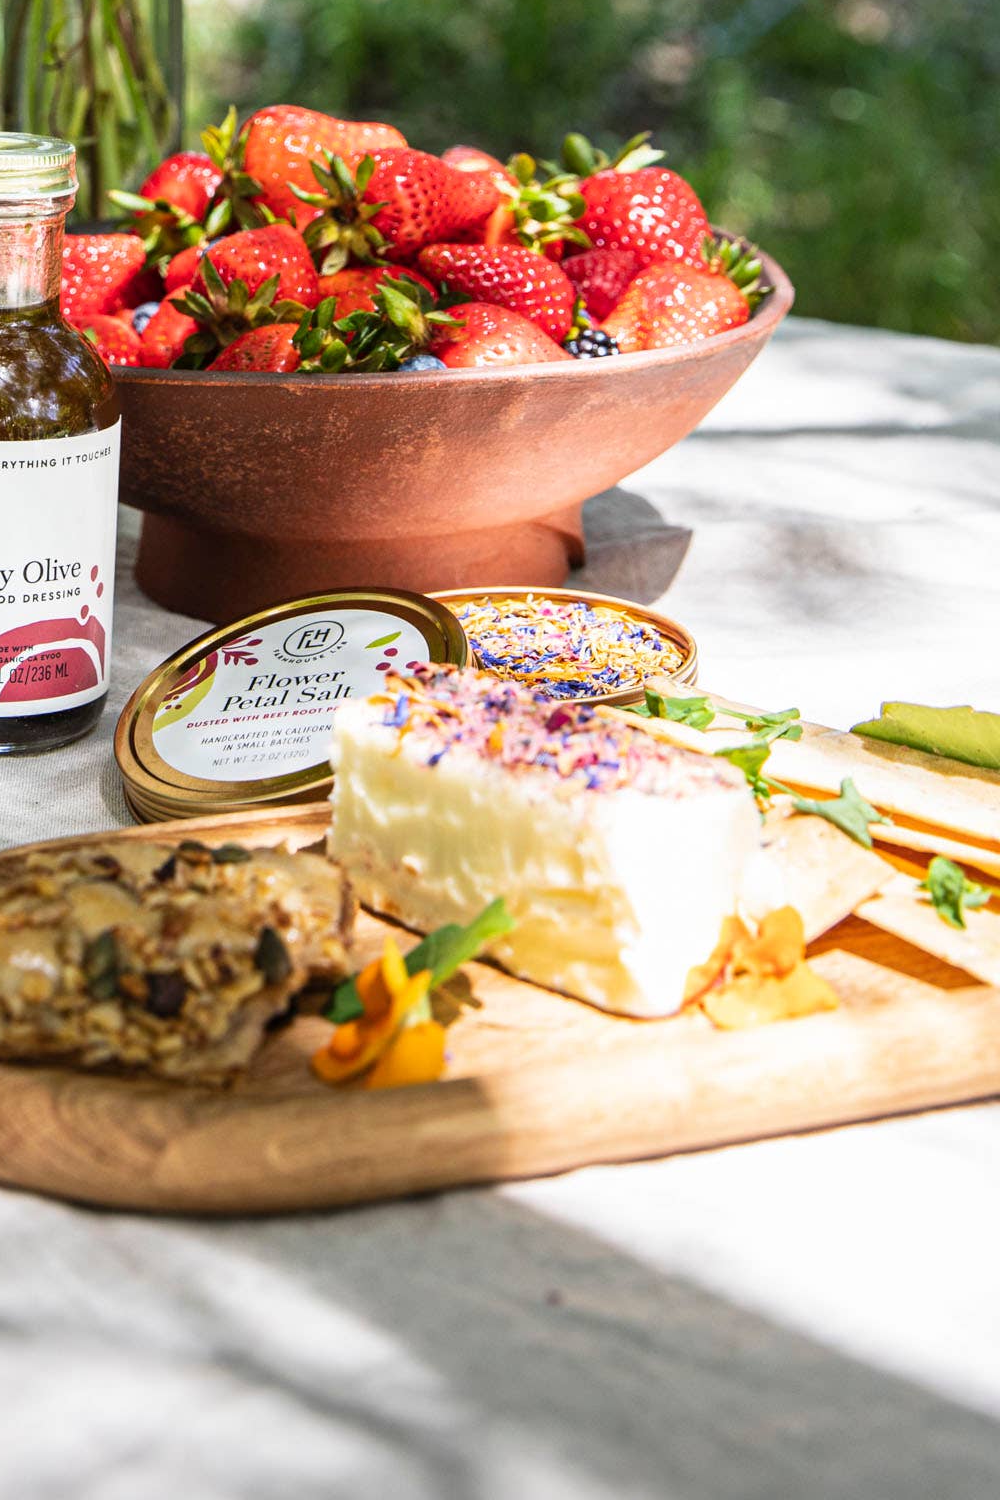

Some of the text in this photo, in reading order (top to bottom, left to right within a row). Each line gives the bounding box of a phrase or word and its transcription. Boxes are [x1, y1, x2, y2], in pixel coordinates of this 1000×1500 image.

[62, 457, 72, 466] IT
[76, 446, 112, 464] TOUCHES
[23, 558, 82, 583] Olive
[23, 587, 81, 603] DRESSING
[41, 652, 62, 661] EVOO
[55, 662, 69, 678] ML
[245, 670, 346, 692] Flower
[221, 684, 354, 712] Petal Salt
[186, 718, 229, 729] DUSTED
[232, 715, 260, 723] WITH
[262, 711, 289, 719] BEET
[292, 707, 324, 716] ROOT
[201, 732, 269, 745] HANDCRAFTED
[237, 741, 266, 750] SMALL
[269, 736, 312, 747] BATCHES
